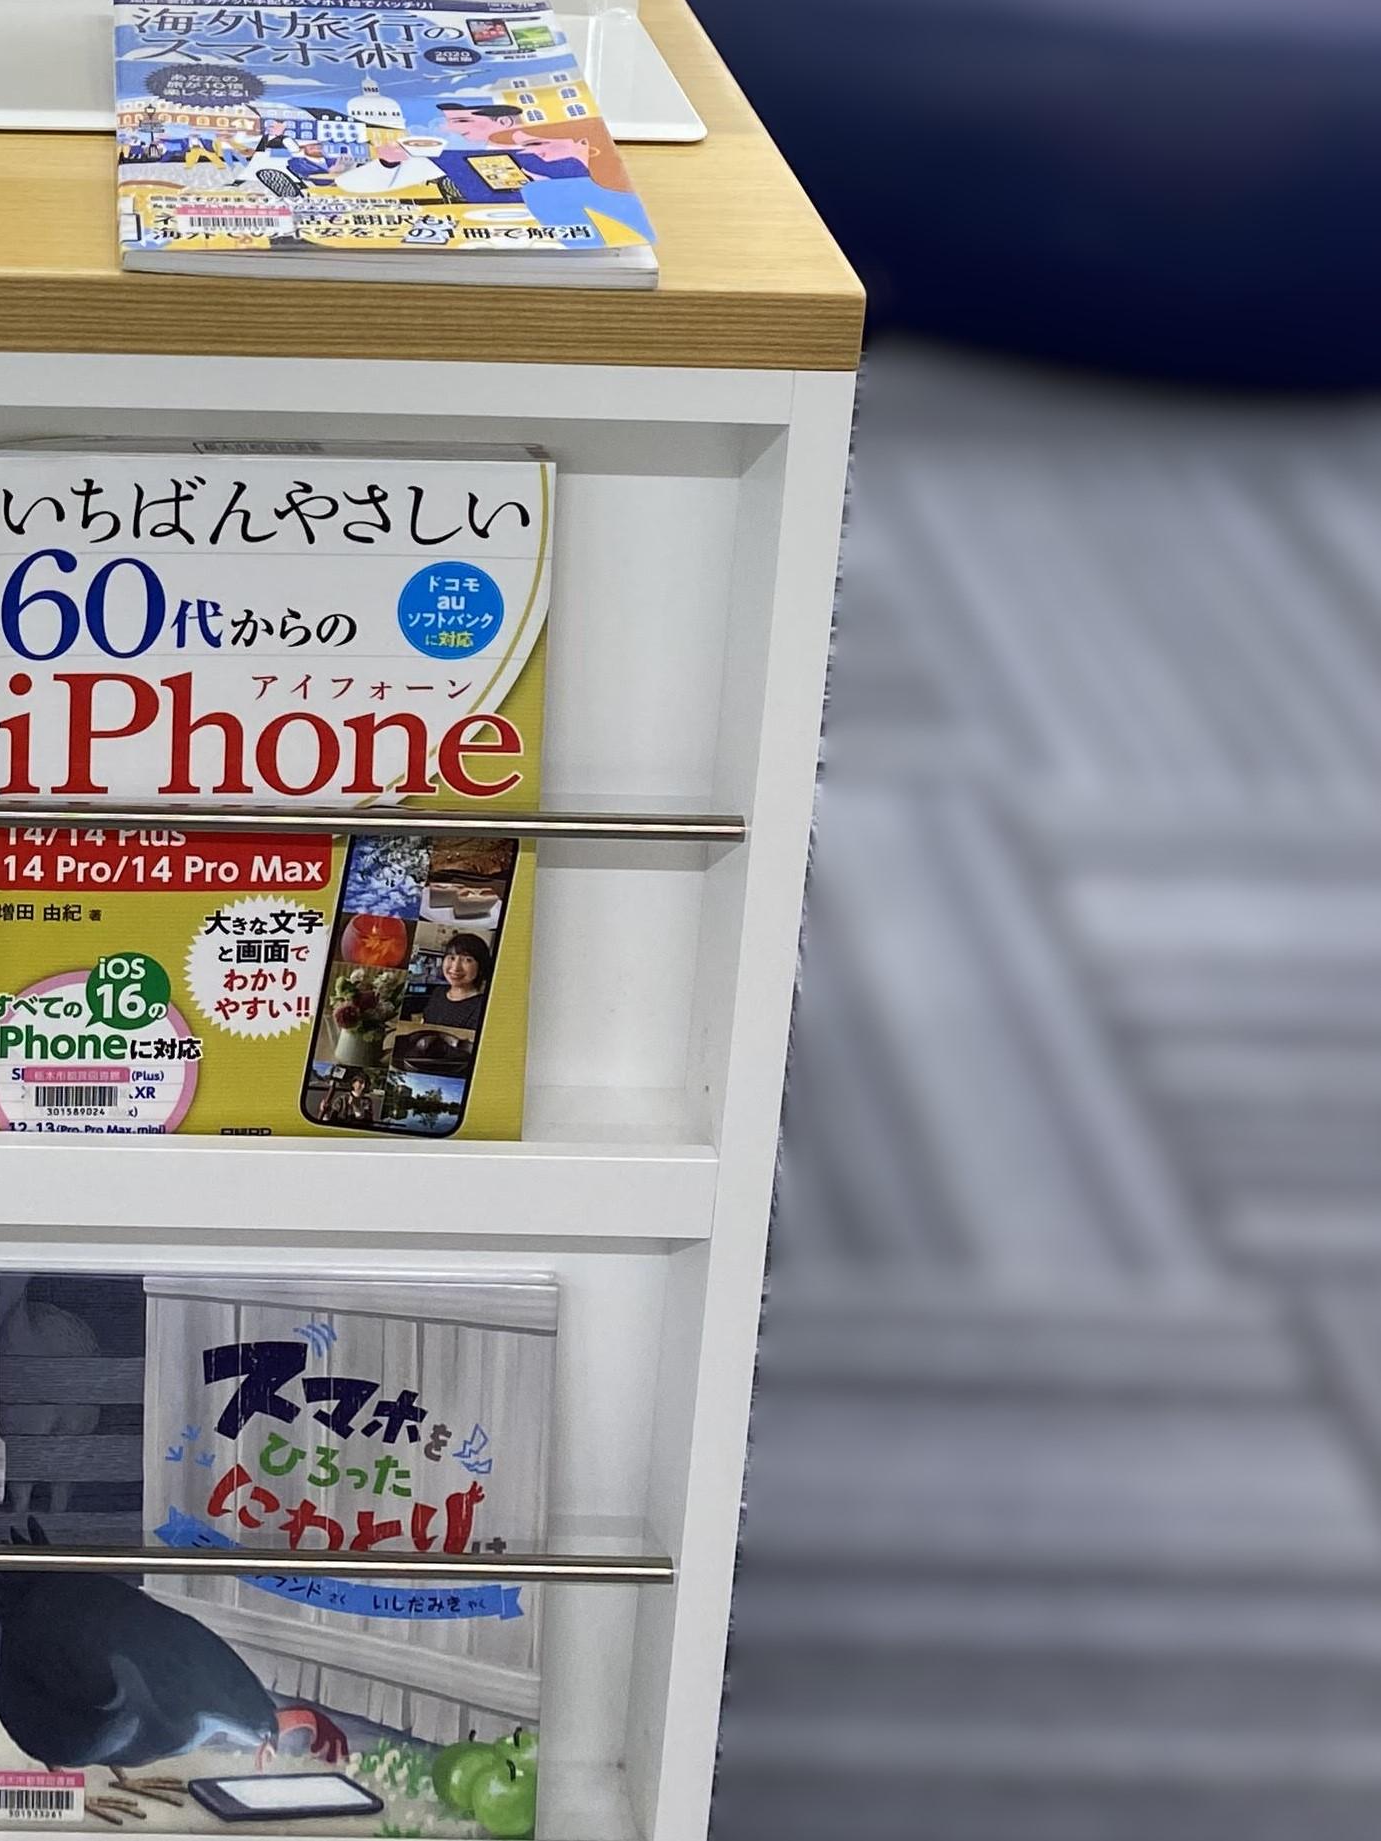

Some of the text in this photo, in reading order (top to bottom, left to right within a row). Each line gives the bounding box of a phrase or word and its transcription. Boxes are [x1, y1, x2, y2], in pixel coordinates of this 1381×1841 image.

[133, 6, 464, 41] 海外旅行の
[134, 37, 419, 69] スマホ術
[171, 74, 238, 82] あなたの
[1, 475, 531, 547] いちばんやさしい
[427, 575, 481, 593] ドコモ
[0, 548, 358, 661] 60代からの
[437, 593, 466, 612] au
[407, 612, 494, 629] ソフトバンク
[425, 631, 474, 648] に対応
[251, 674, 472, 700] アイフォーン
[2, 856, 323, 884] 14 Pro/14 Pro Max
[42, 903, 82, 922] 由紀
[204, 910, 324, 936] 大きな文字
[217, 939, 310, 964] と画面で
[98, 957, 146, 981] iOS
[223, 968, 298, 993] わかり
[131, 1070, 165, 1082] (Plus)
[203, 1340, 453, 1461] スマホを
[259, 1432, 413, 1497] ひろった
[373, 1595, 461, 1612] いしだみき
